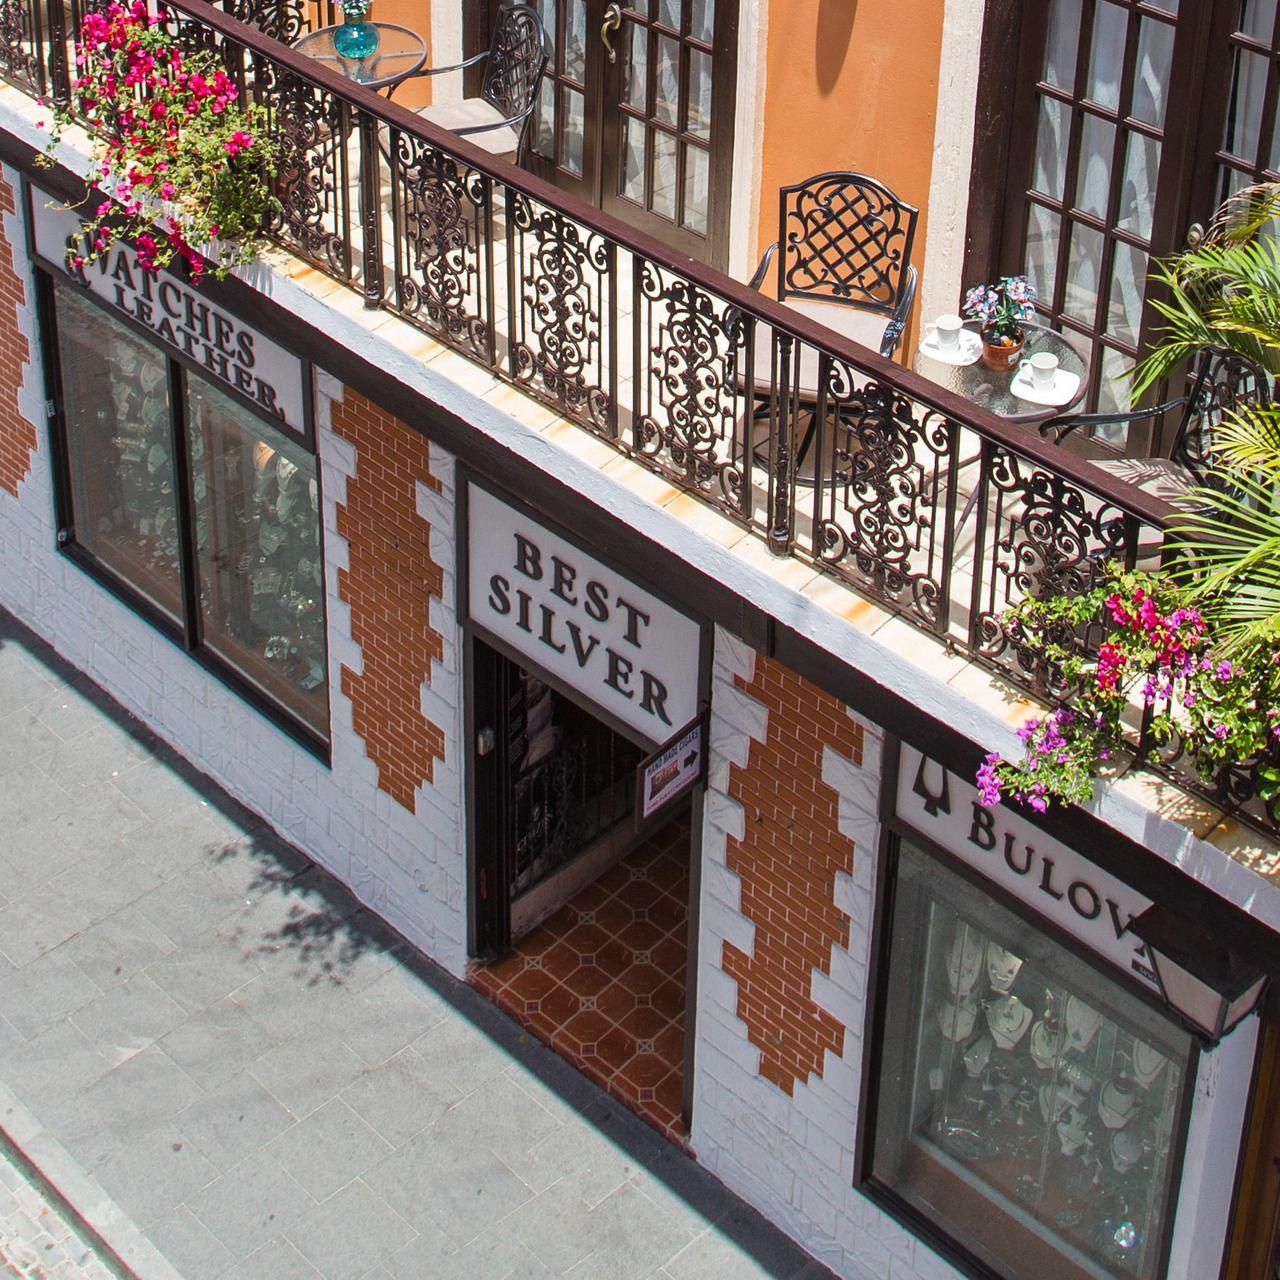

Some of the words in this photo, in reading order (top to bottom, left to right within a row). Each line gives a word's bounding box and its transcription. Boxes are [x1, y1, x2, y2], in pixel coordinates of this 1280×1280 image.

[112, 282, 286, 423] LEATHER
[487, 574, 673, 727] SILVER
[513, 532, 651, 649] BEST
[647, 755, 663, 777] HAND
[663, 742, 678, 763] MADE
[678, 728, 699, 751] CIGARS
[967, 800, 1146, 958] BULOV
